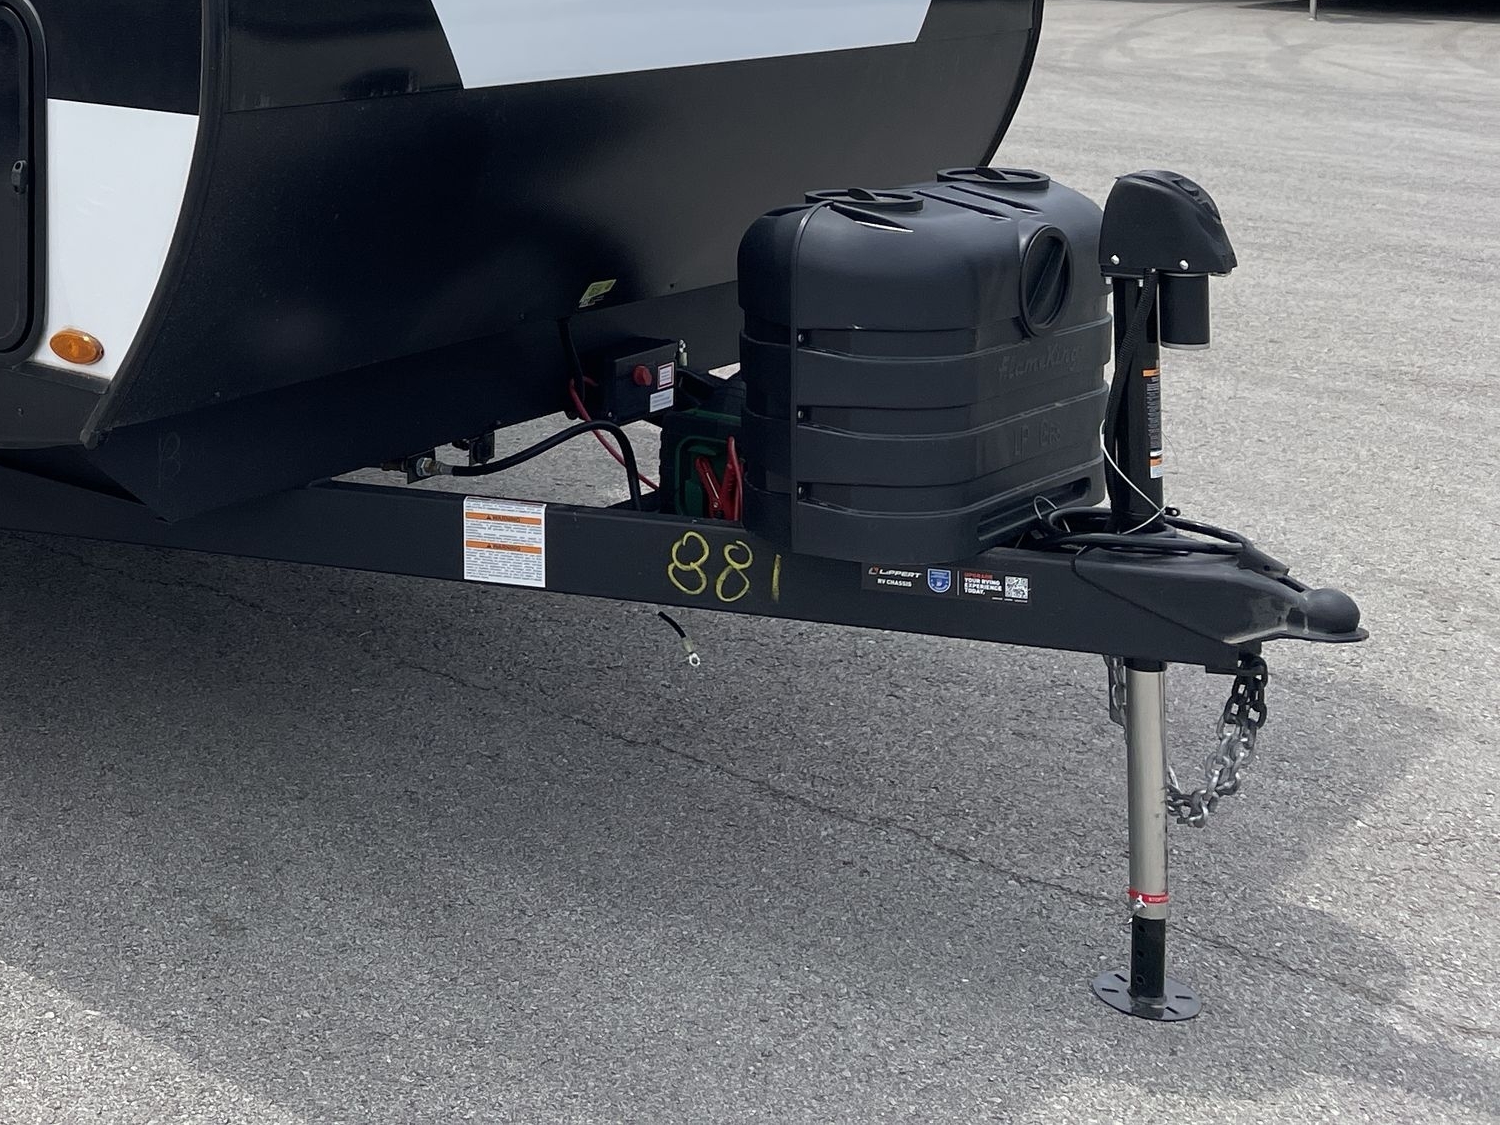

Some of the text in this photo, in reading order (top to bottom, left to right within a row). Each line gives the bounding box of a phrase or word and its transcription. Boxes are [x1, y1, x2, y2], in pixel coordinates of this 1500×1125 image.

[666, 529, 782, 604] 881
[879, 568, 922, 578] LIPPERT
[886, 579, 912, 587] CHASSIS
[964, 583, 1003, 591] EXPERIENCE
